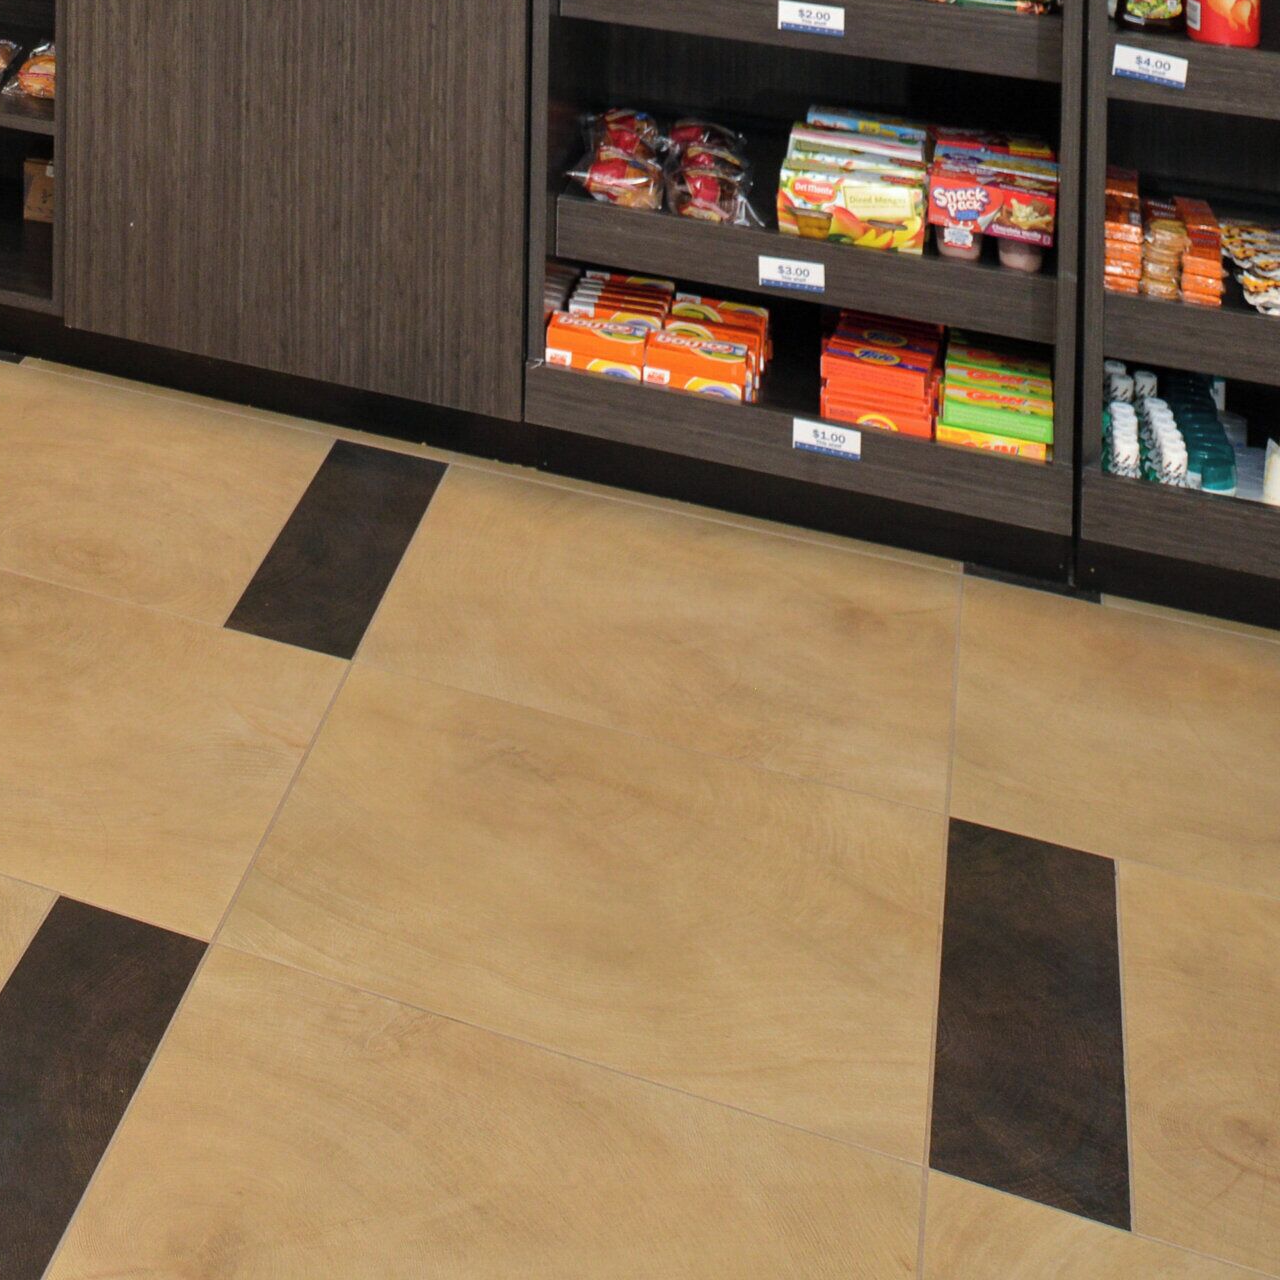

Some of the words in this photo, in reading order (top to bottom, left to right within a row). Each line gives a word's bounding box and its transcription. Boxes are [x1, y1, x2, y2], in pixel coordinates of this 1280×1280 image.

[798, 9, 830, 20] $2.00
[1135, 56, 1171, 71] $4.00
[933, 188, 988, 207] Snack
[948, 200, 983, 214] Pack
[778, 265, 810, 277] $3.00
[813, 430, 846, 443] $1.00
